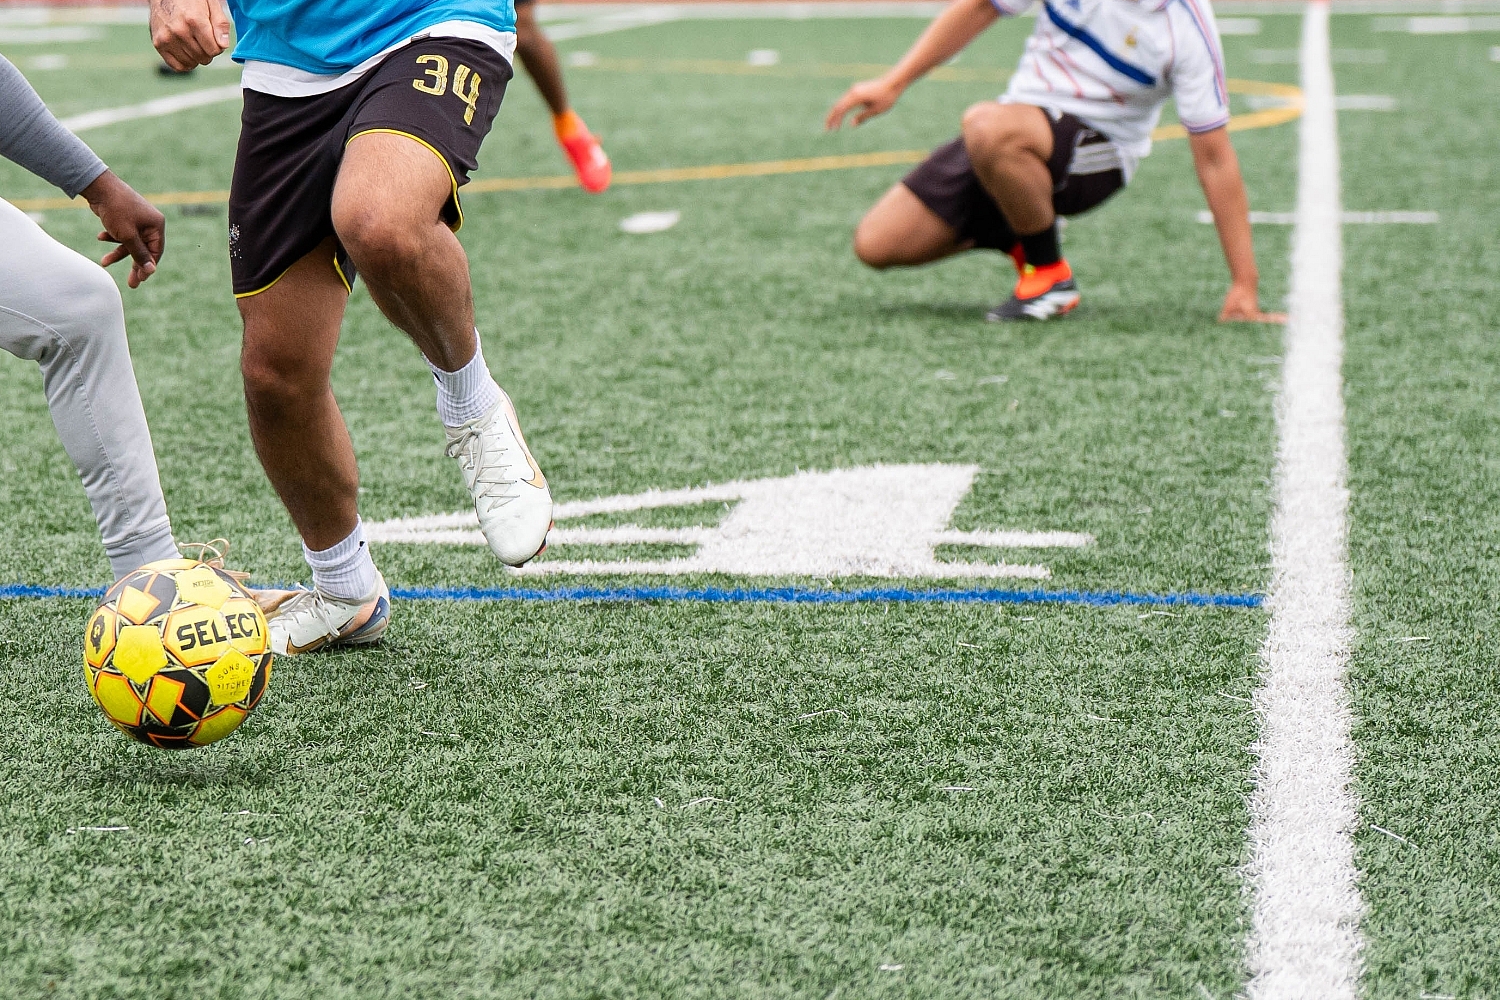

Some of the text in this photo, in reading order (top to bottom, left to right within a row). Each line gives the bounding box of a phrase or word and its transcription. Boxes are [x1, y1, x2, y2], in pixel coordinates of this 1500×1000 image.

[412, 54, 482, 126] 34
[176, 612, 261, 651] SELECT
[217, 662, 240, 680] SONS
